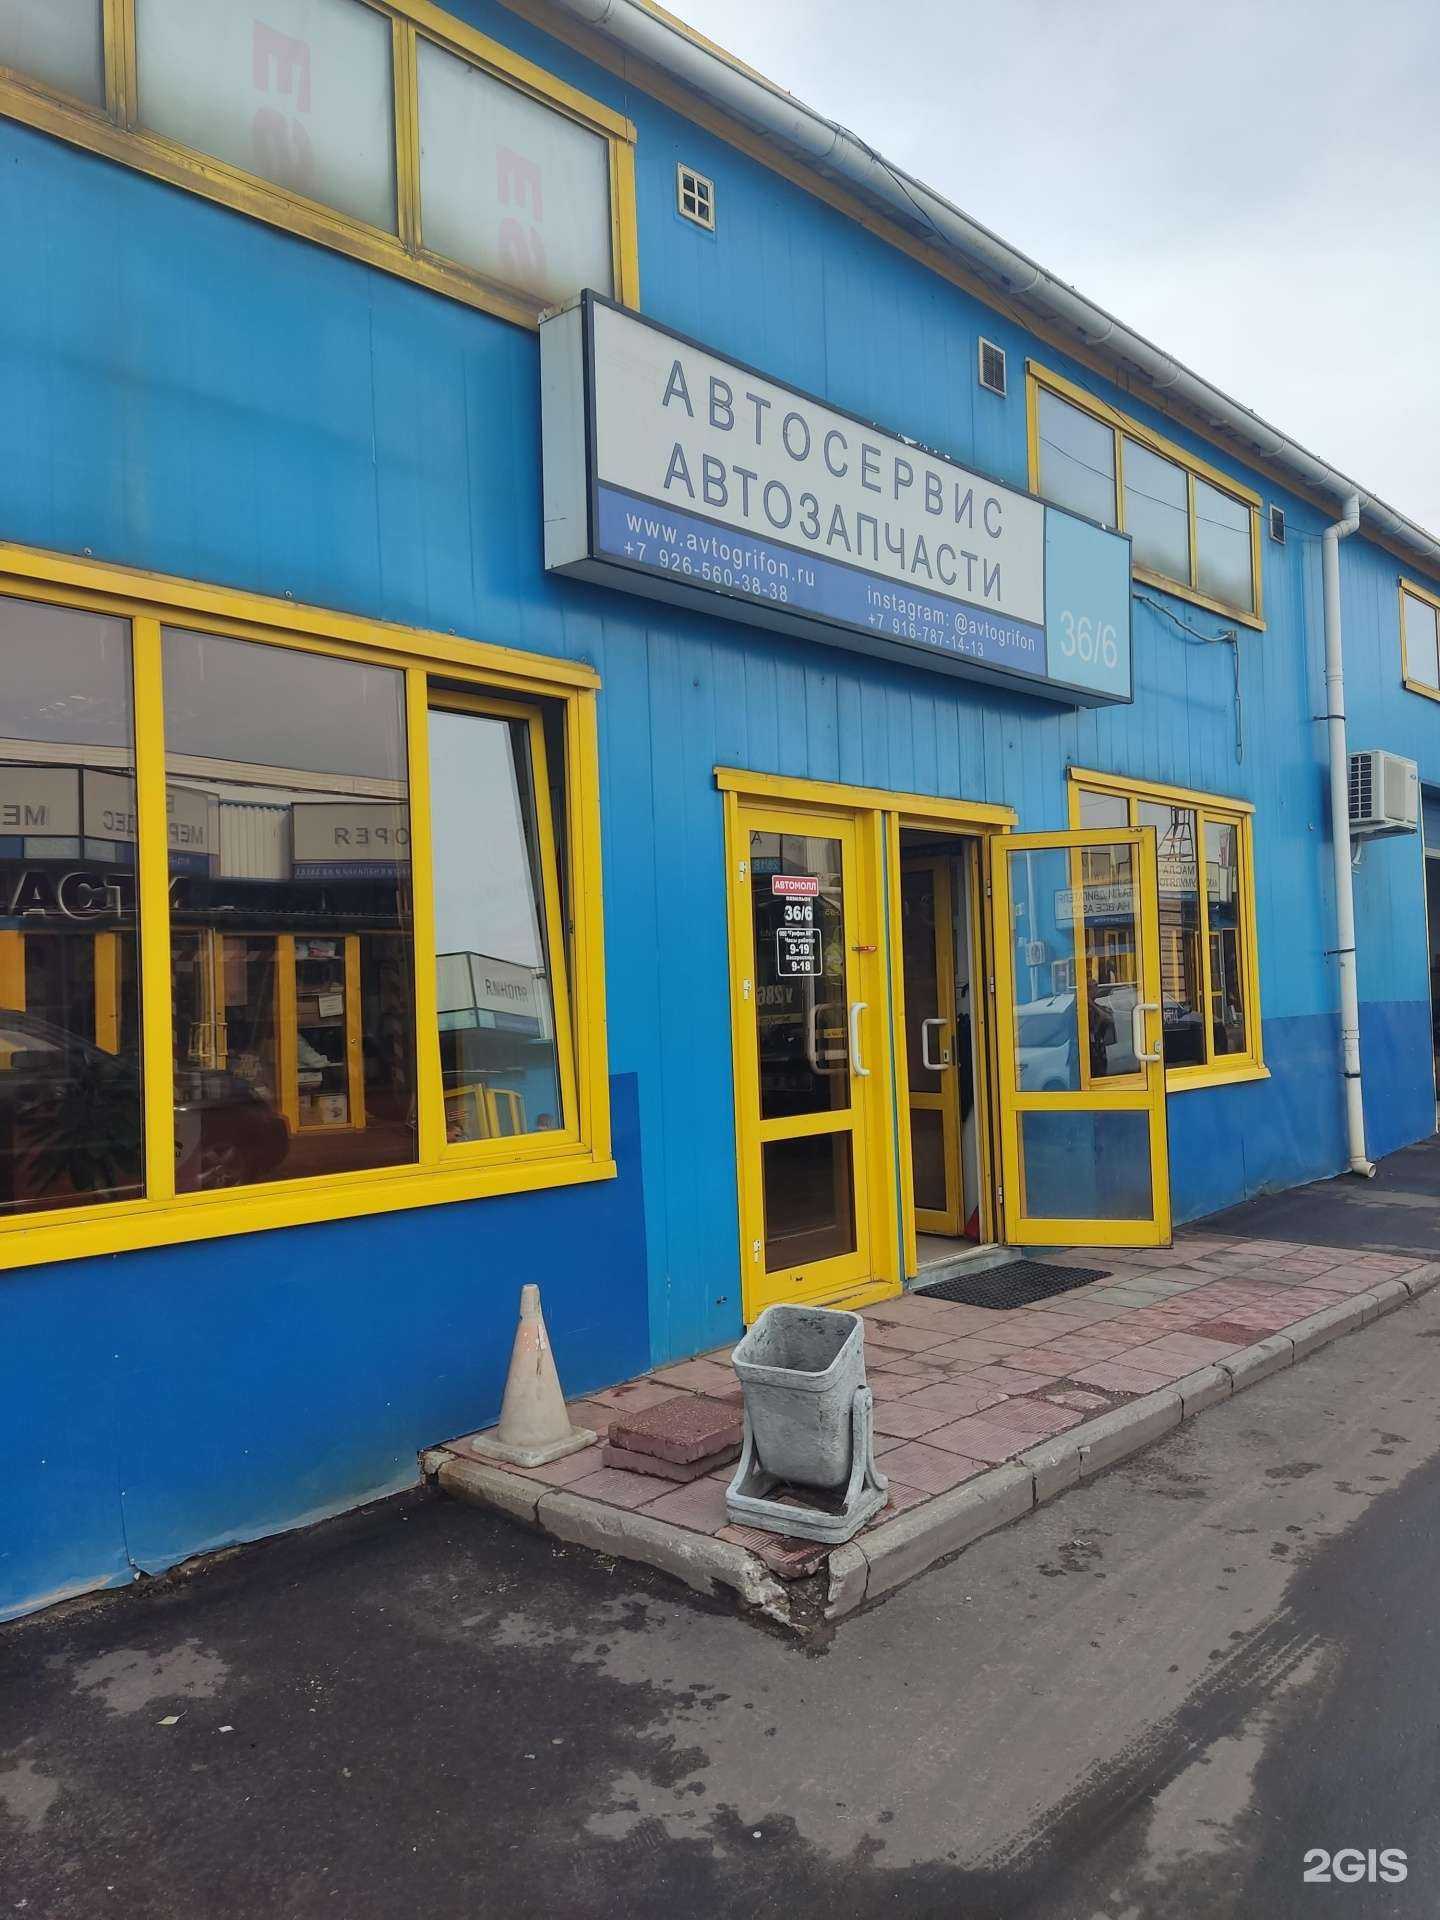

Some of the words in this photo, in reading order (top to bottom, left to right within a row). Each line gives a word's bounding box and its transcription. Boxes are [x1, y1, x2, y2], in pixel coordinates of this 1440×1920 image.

[661, 359, 1004, 539] АВТОСЕРВИС
[625, 512, 816, 587] www.avtogrifon.ru
[663, 442, 1003, 602] АВТОЗАПЧАСТИ
[623, 541, 647, 561] +7
[658, 549, 789, 603] 926-560-38-38
[865, 585, 950, 627] instagram:
[954, 612, 1037, 653] @avtogrifon
[867, 613, 884, 628] +7
[892, 617, 985, 657] 916-787-14-13
[1060, 609, 1119, 669] 36/6
[774, 880, 817, 892] АВТОМОЛЛ
[784, 905, 813, 921] 36/6
[789, 944, 810, 955] 9-19
[791, 961, 811, 972] 9-18
